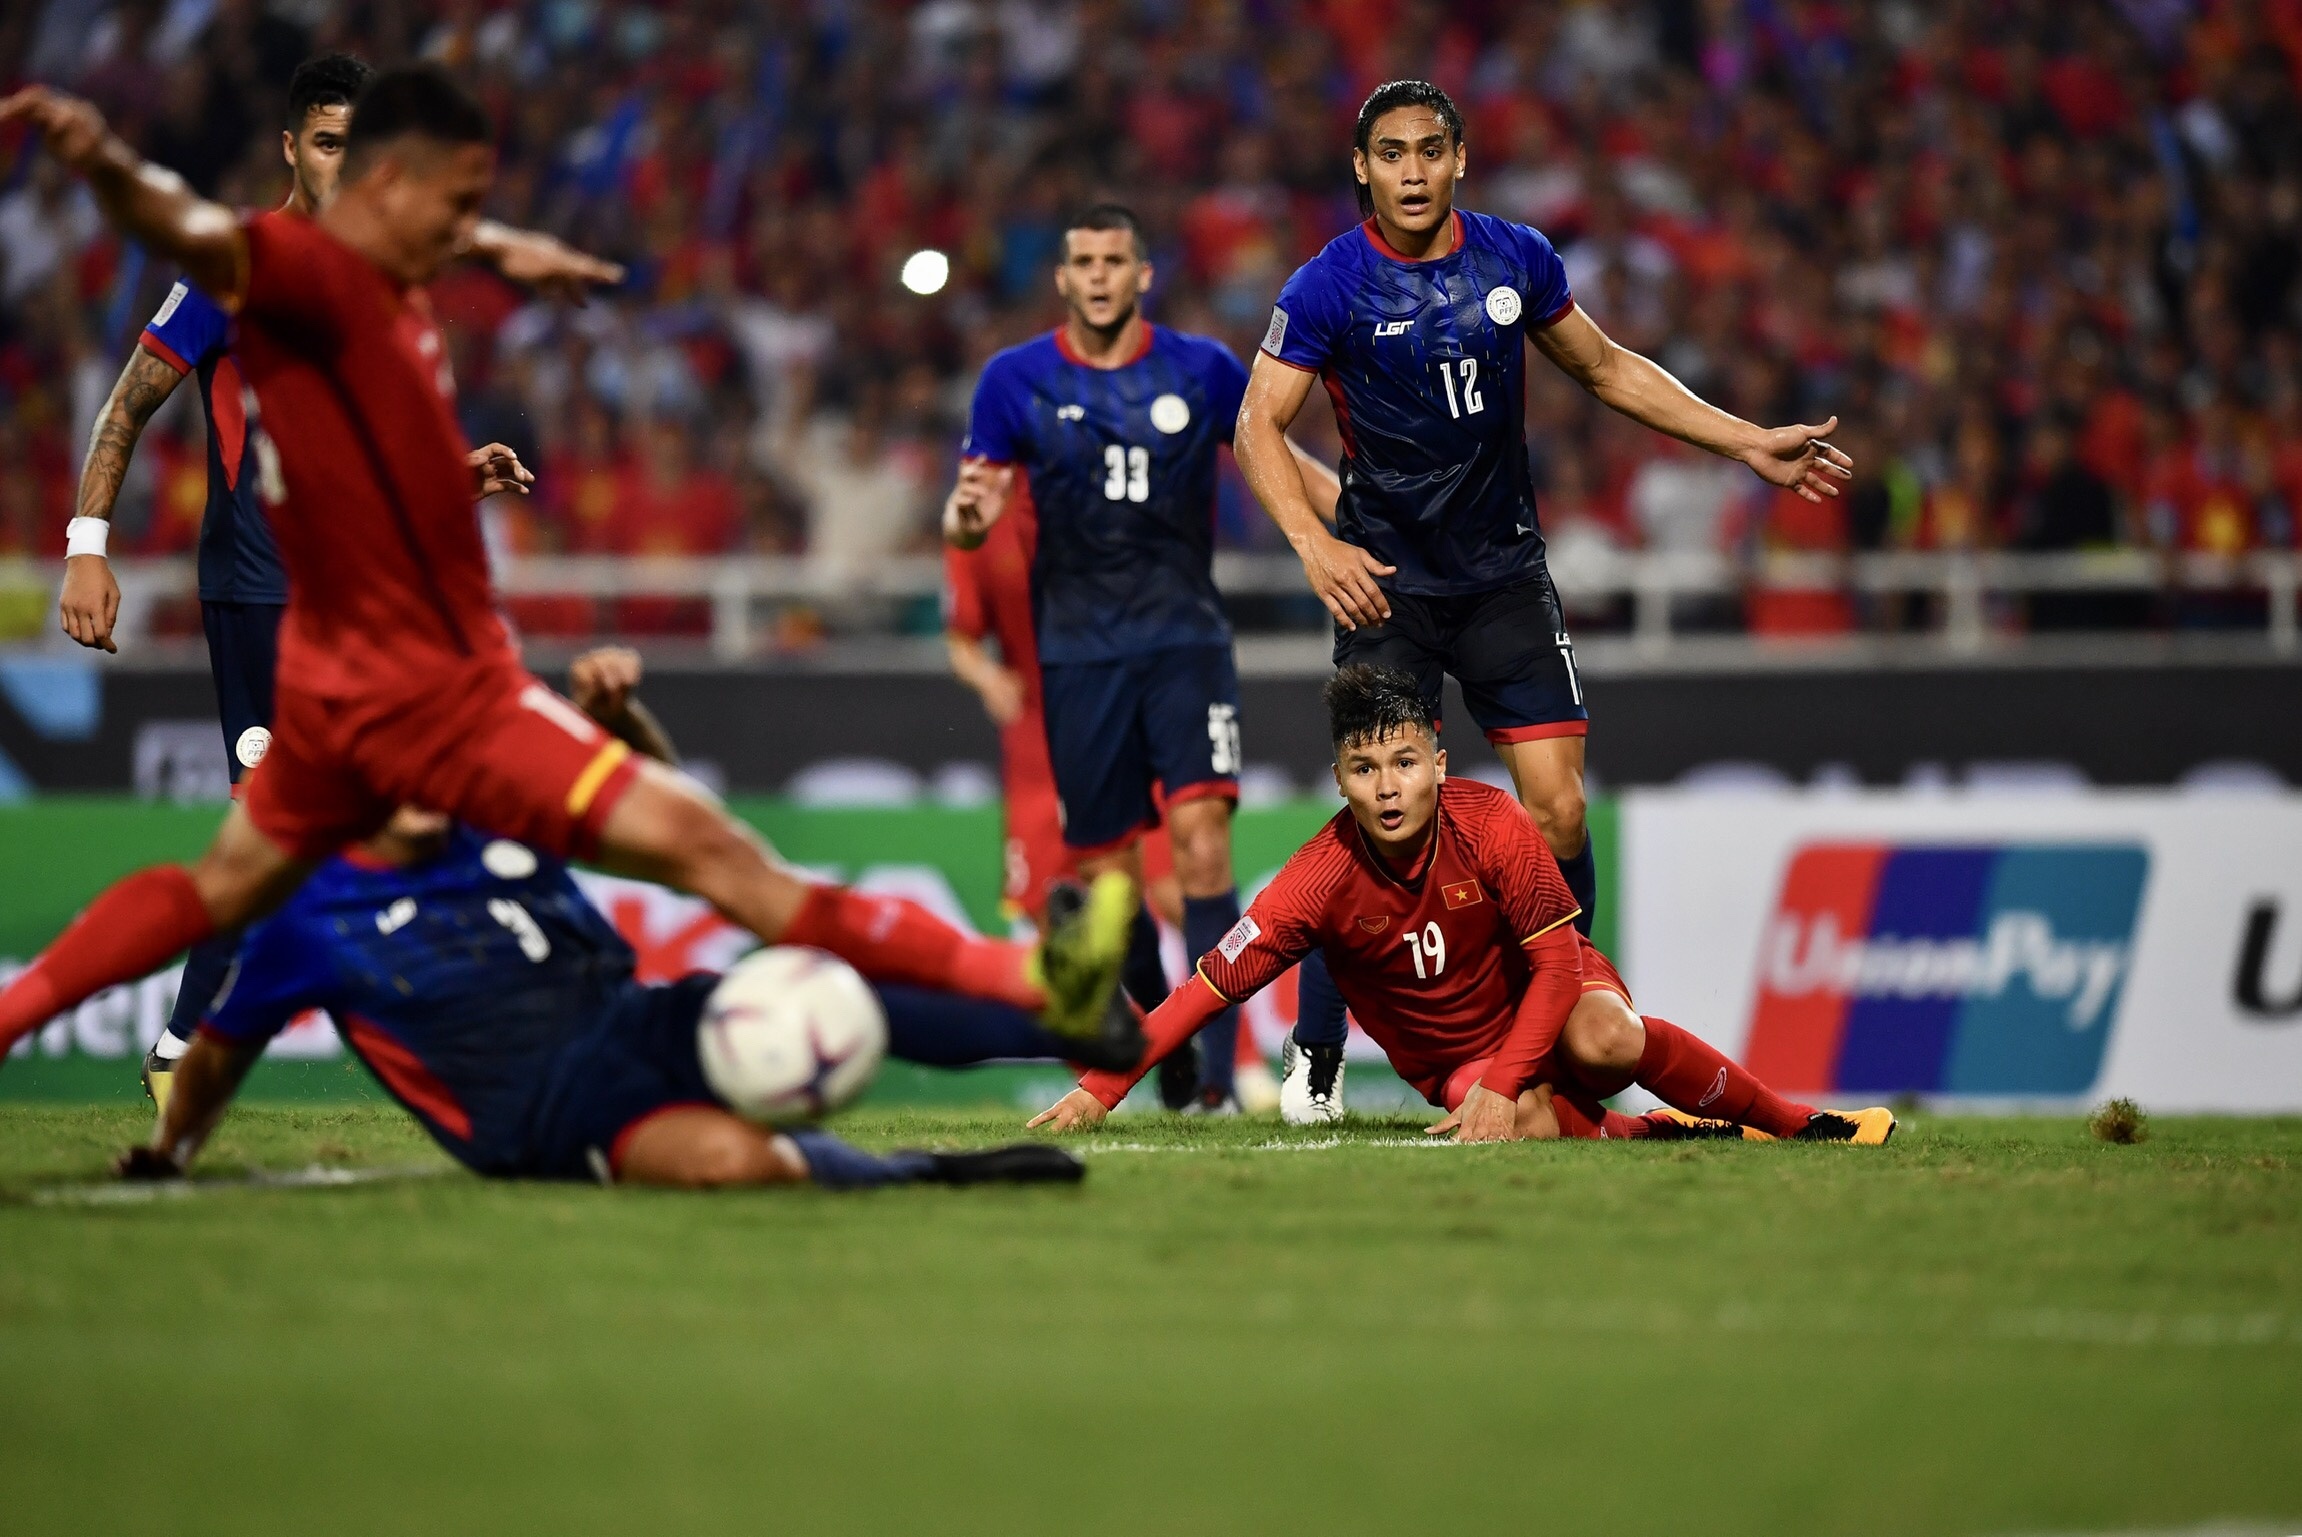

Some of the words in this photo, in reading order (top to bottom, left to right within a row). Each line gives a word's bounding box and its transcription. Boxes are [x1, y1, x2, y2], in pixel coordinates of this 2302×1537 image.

[1440, 357, 1484, 419] 12
[1104, 444, 1149, 503] 33
[1555, 632, 1571, 645] LG
[1560, 648, 1583, 705] 1
[1402, 920, 1446, 979] 19
[1765, 906, 2124, 1032] UnionPay
